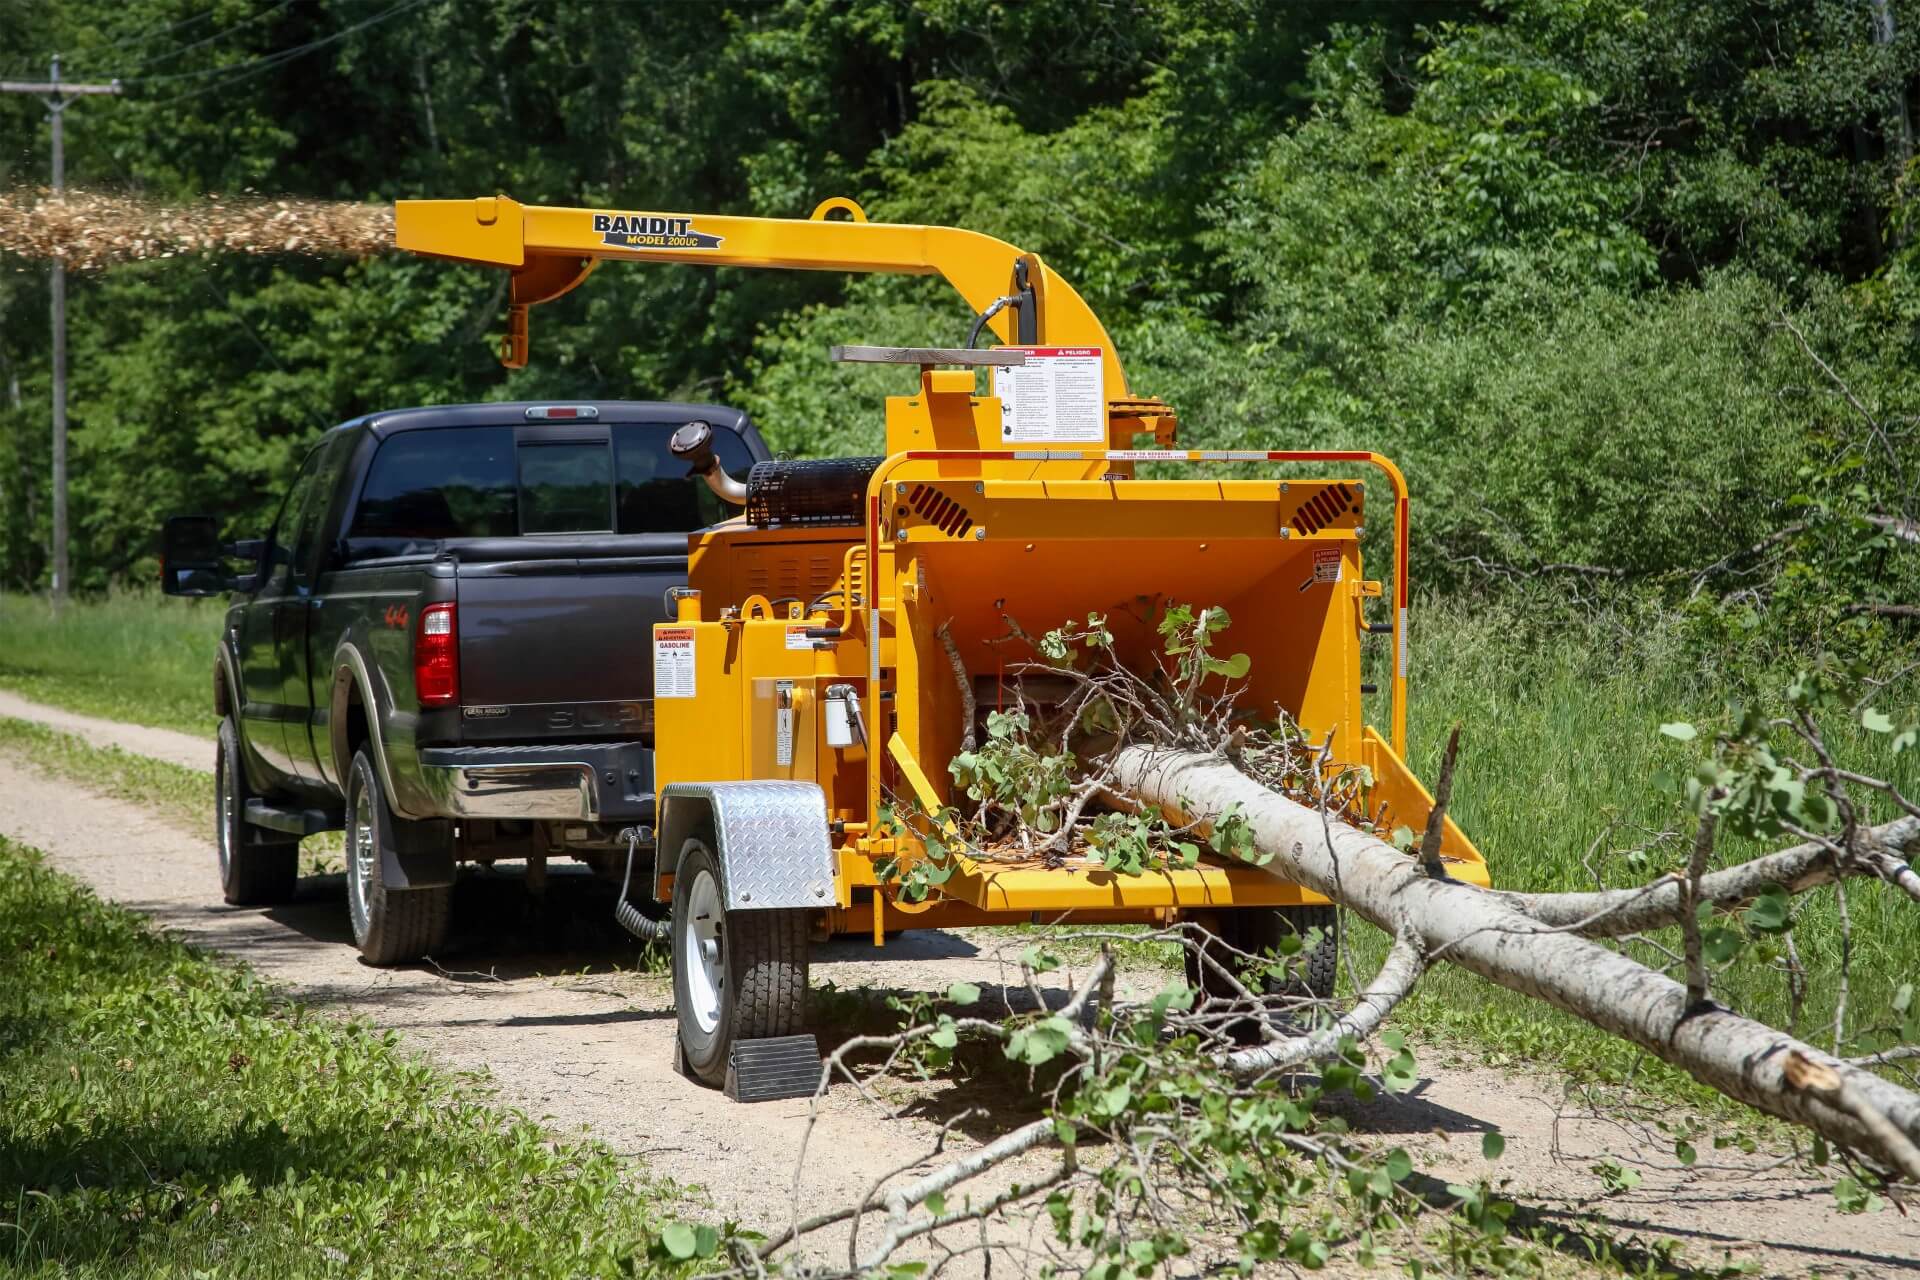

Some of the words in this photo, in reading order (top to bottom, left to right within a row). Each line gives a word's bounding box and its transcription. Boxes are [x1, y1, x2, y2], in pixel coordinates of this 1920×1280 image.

[594, 215, 691, 236] BANDIT
[626, 235, 665, 246] MODEL
[667, 237, 699, 247] 200UC
[1065, 349, 1091, 357] PELIGRO
